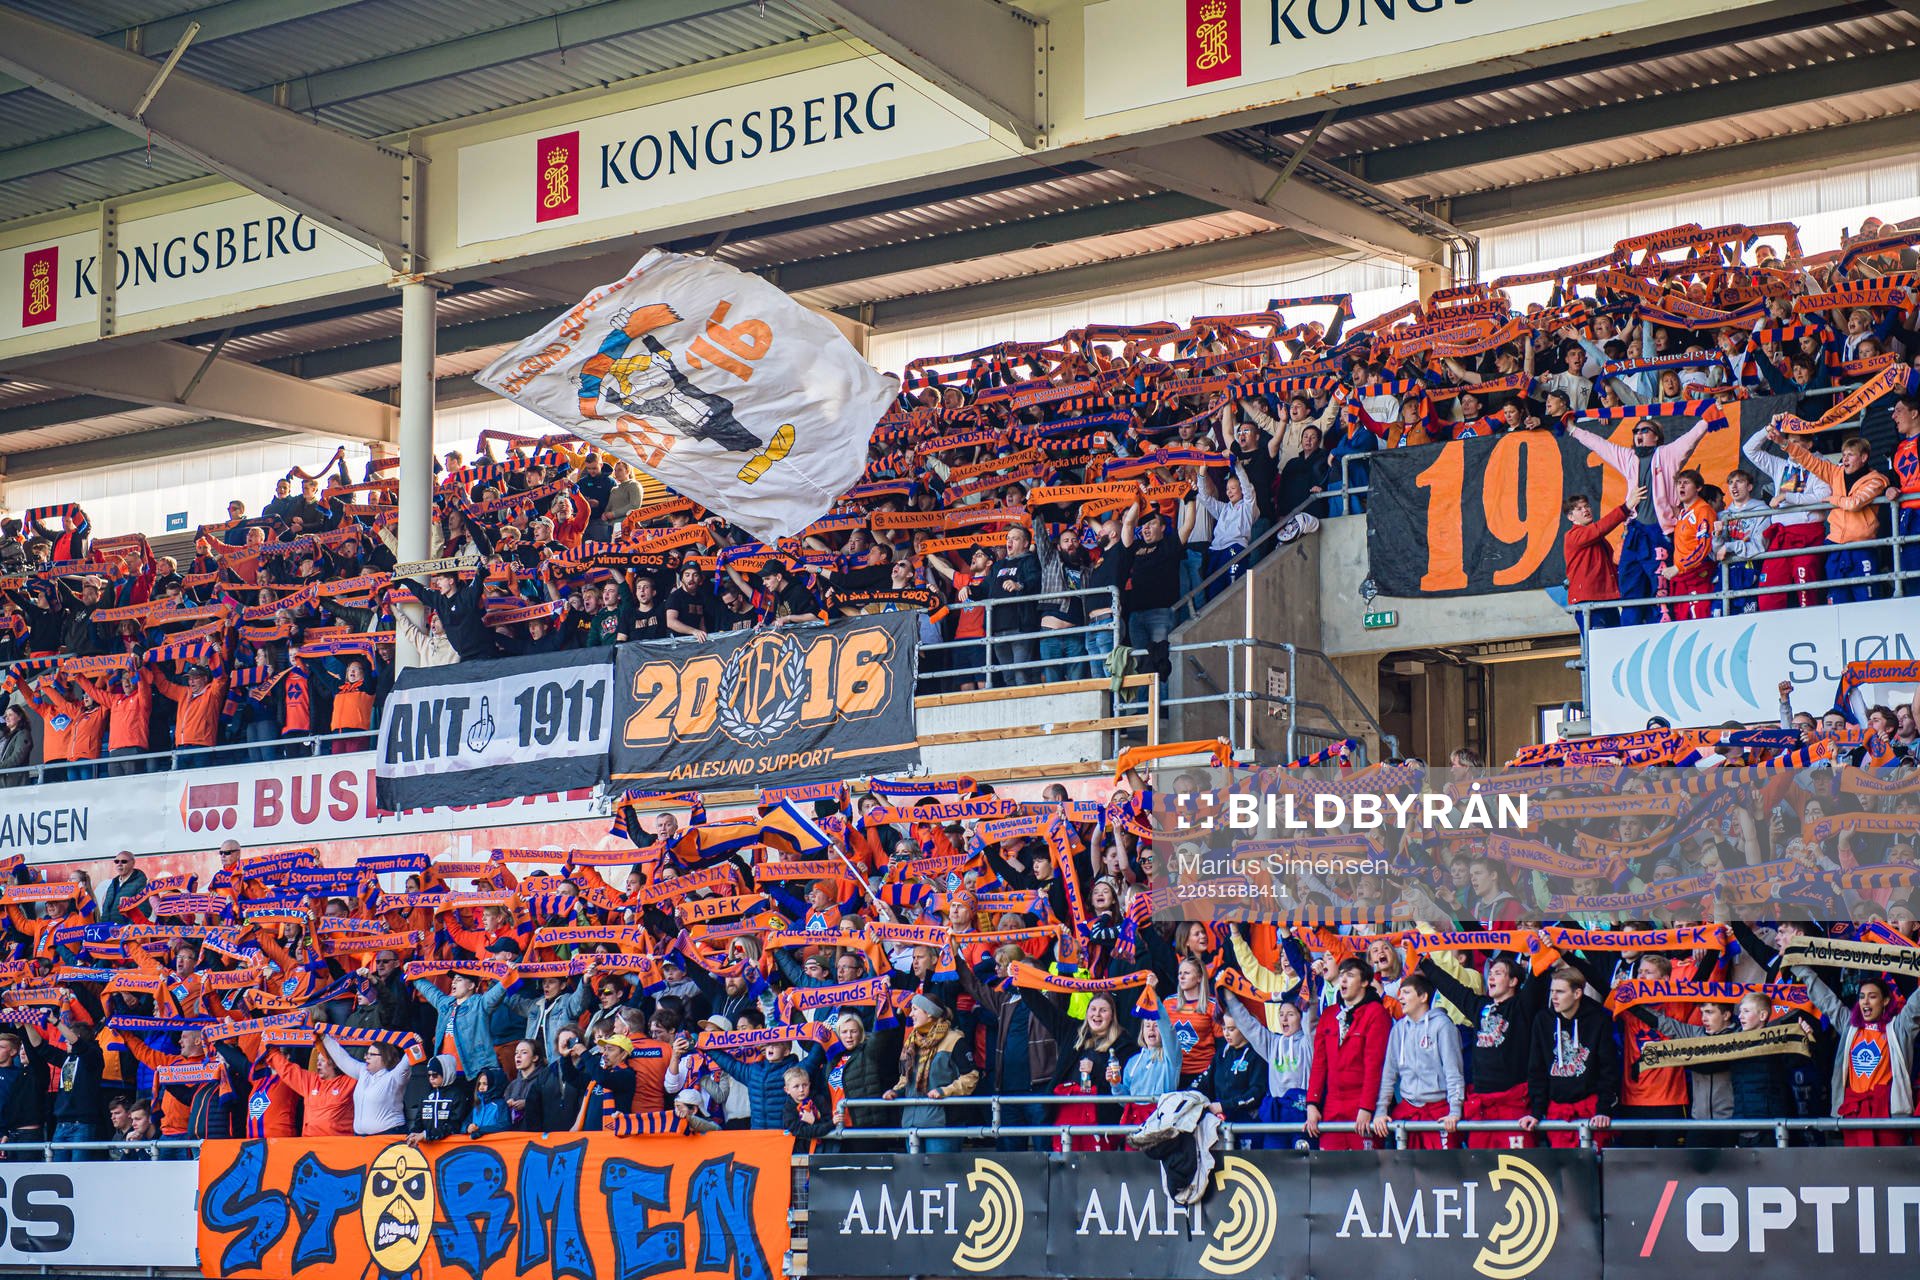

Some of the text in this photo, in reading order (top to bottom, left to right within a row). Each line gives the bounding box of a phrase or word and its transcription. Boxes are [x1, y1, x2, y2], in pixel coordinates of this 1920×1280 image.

[600, 82, 896, 190] KONGSBERG
[1717, 227, 1732, 240] FK
[1799, 290, 1882, 311] AALESUNDS FK
[1613, 357, 1638, 371] FK
[1037, 487, 1094, 498] AALESUND
[1145, 485, 1177, 497] PPORT
[1087, 498, 1121, 512] AALESU
[887, 511, 934, 523] AALESUND
[597, 555, 664, 566] vinne OBOS
[514, 679, 608, 748] 1911
[669, 747, 834, 781] AALESUND SUPPORT
[1560, 766, 1584, 782] FK
[920, 801, 997, 820] AALESUNDS
[289, 872, 336, 884] Stormen
[337, 870, 352, 882] for
[710, 866, 726, 880] FK
[765, 861, 842, 877] AALESUNDS FK
[693, 896, 741, 918] AaFK
[132, 926, 176, 937] AAFK
[535, 927, 642, 945] Aalesunds FK
[928, 927, 946, 943] FK
[1442, 931, 1511, 945] Stormen
[1555, 927, 1707, 947] Aalesunds FK
[1803, 942, 1891, 966] Aalesunds
[799, 986, 867, 1007] Aalesunds
[1637, 980, 1789, 1001] AALESUNDS FK
[705, 1024, 807, 1047] Aalesunds FK
[0, 1173, 76, 1254] S
[840, 1182, 958, 1240] AMFI
[1336, 1181, 1479, 1245] AMFI
